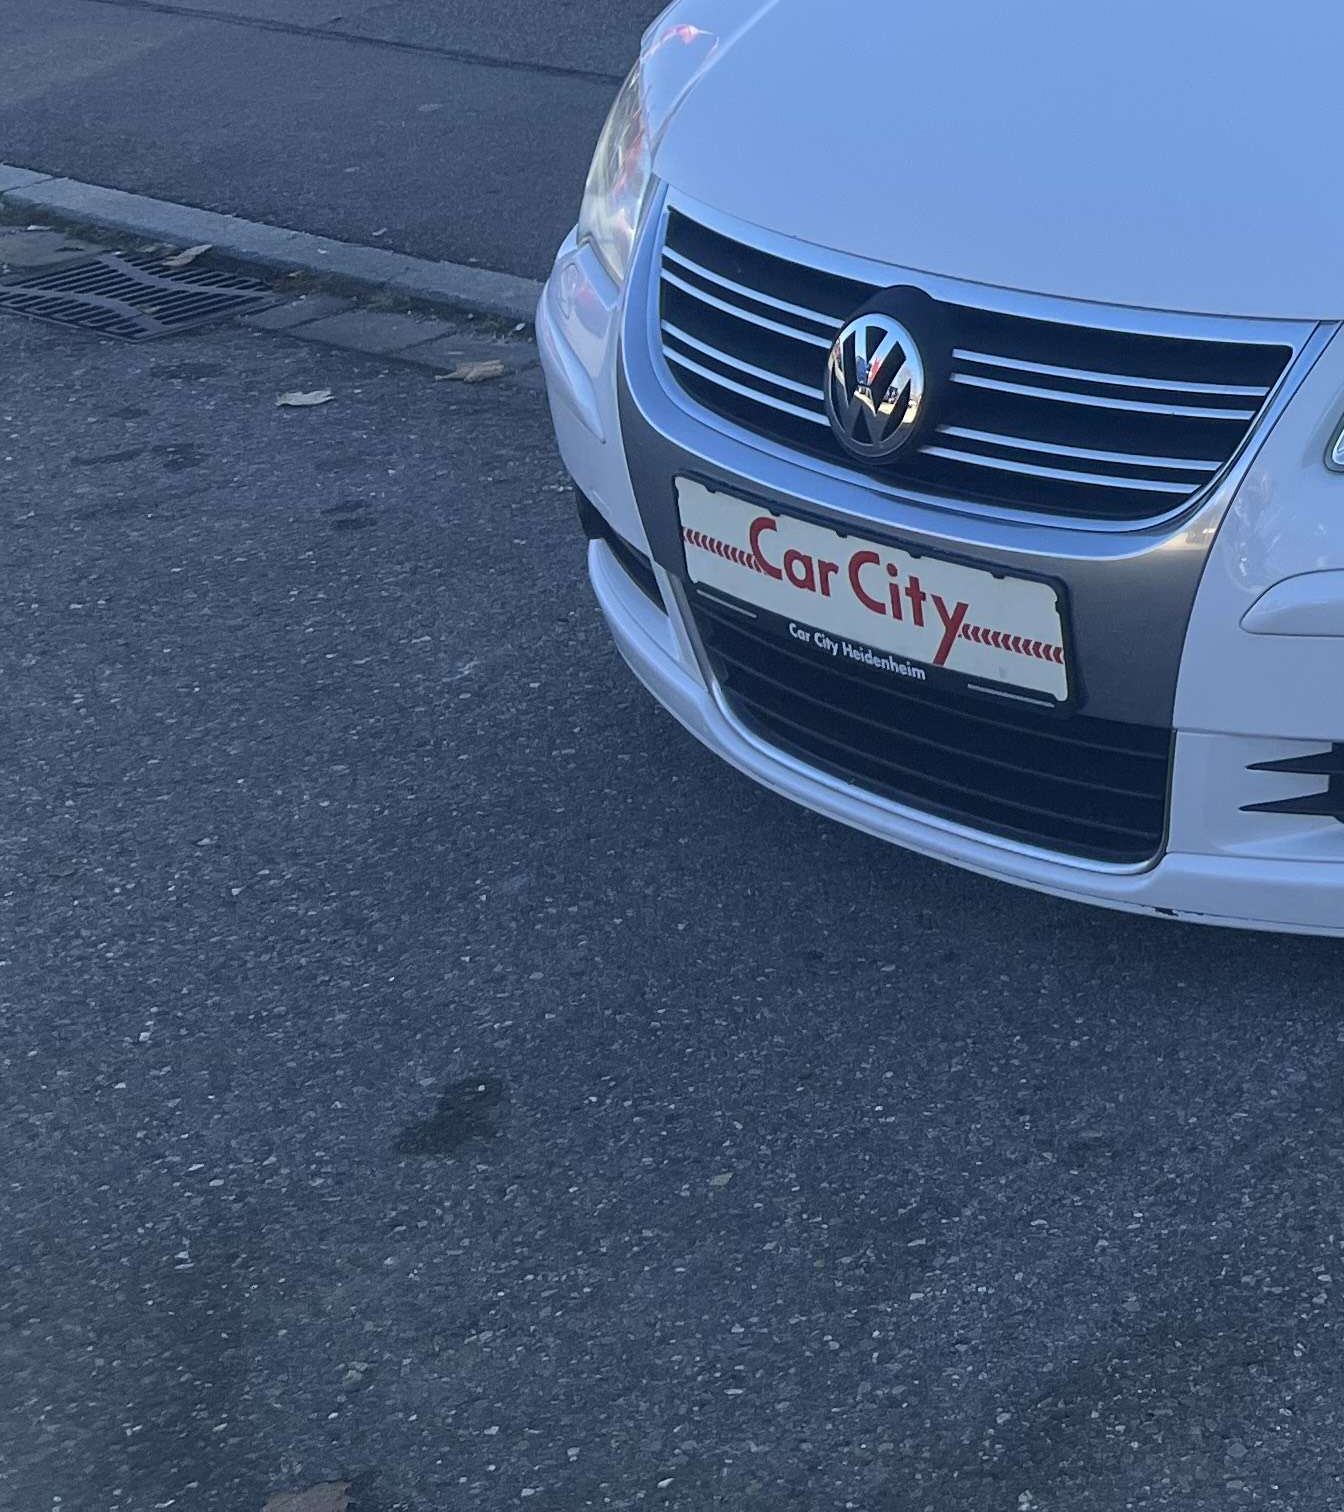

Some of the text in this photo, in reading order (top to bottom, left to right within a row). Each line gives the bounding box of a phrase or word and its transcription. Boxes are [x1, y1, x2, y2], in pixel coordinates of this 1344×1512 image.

[788, 621, 927, 682] Car City Heidenheim
